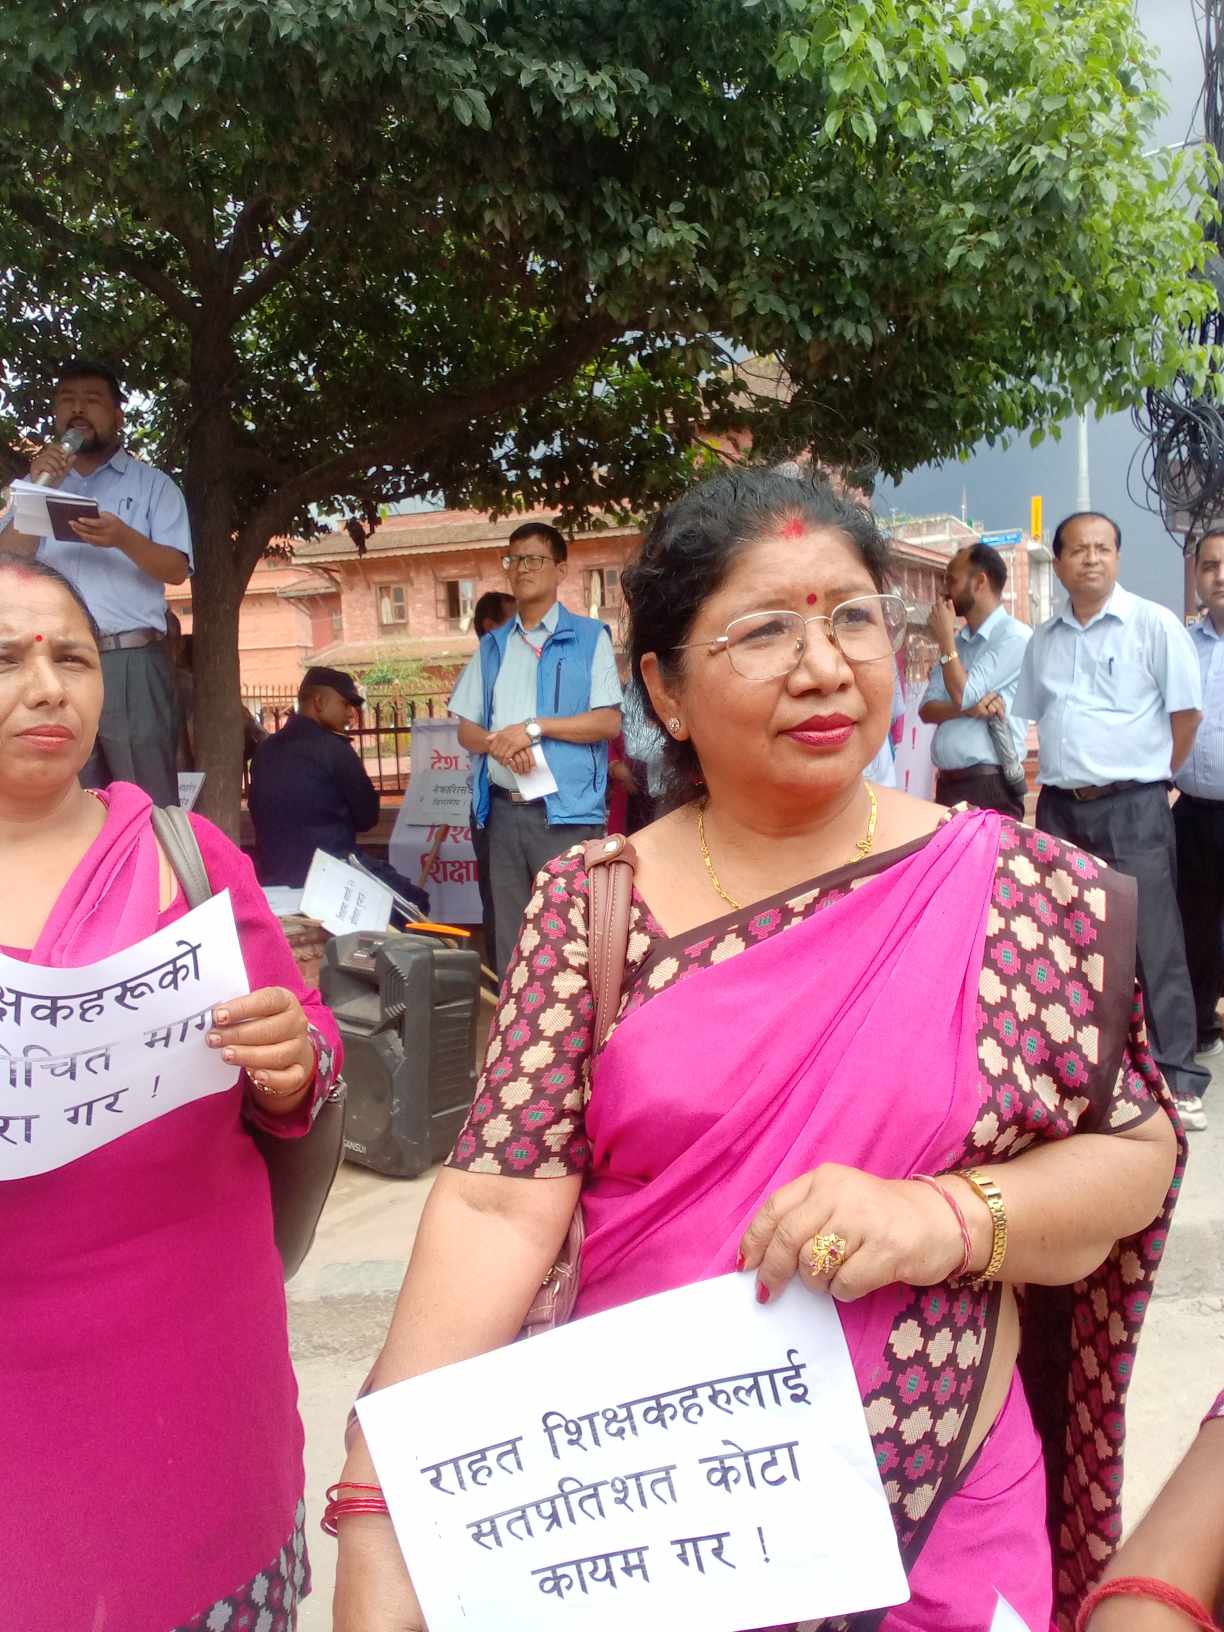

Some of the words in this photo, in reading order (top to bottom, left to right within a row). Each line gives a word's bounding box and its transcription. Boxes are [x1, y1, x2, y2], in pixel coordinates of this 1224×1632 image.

[64, 1088, 129, 1126] गर
[151, 1075, 160, 1098] !
[420, 1435, 523, 1495] राहत
[542, 1349, 812, 1460] शिक्षकहरुलाई
[466, 1464, 677, 1550] सतप्रतिशत
[698, 1440, 800, 1494] कोटा
[530, 1545, 650, 1600] कायम
[670, 1531, 736, 1575] गर
[756, 1526, 770, 1563] !
